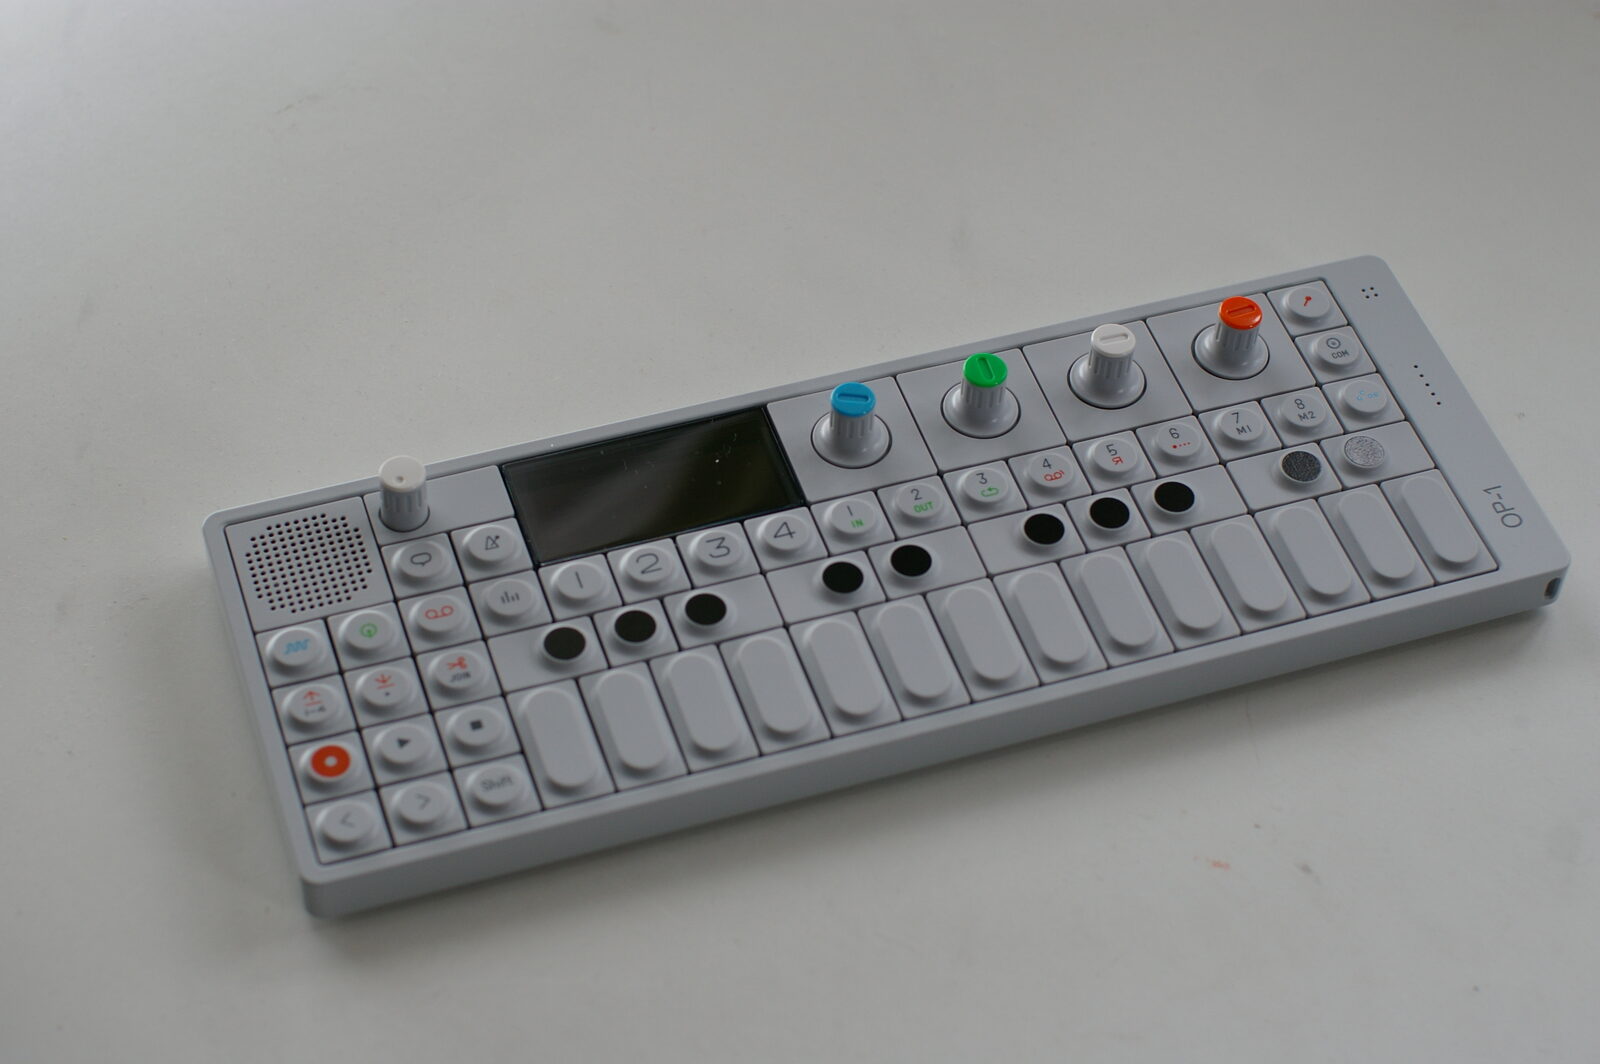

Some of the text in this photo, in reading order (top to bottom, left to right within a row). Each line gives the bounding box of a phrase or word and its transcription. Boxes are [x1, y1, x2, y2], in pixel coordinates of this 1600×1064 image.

[1331, 349, 1350, 360] COM
[1294, 398, 1306, 410] 8
[1231, 411, 1240, 424] 7
[1297, 410, 1317, 422] M2
[1168, 427, 1180, 440] 6
[1105, 443, 1118, 456] 5
[1042, 457, 1052, 470] 4
[976, 472, 988, 485] 3
[910, 488, 923, 500] 2
[913, 501, 934, 513] OUT
[1482, 485, 1523, 528] OP-1
[773, 521, 796, 540] 4
[850, 519, 865, 529] IN
[705, 536, 731, 559] 3
[635, 552, 662, 575] 2
